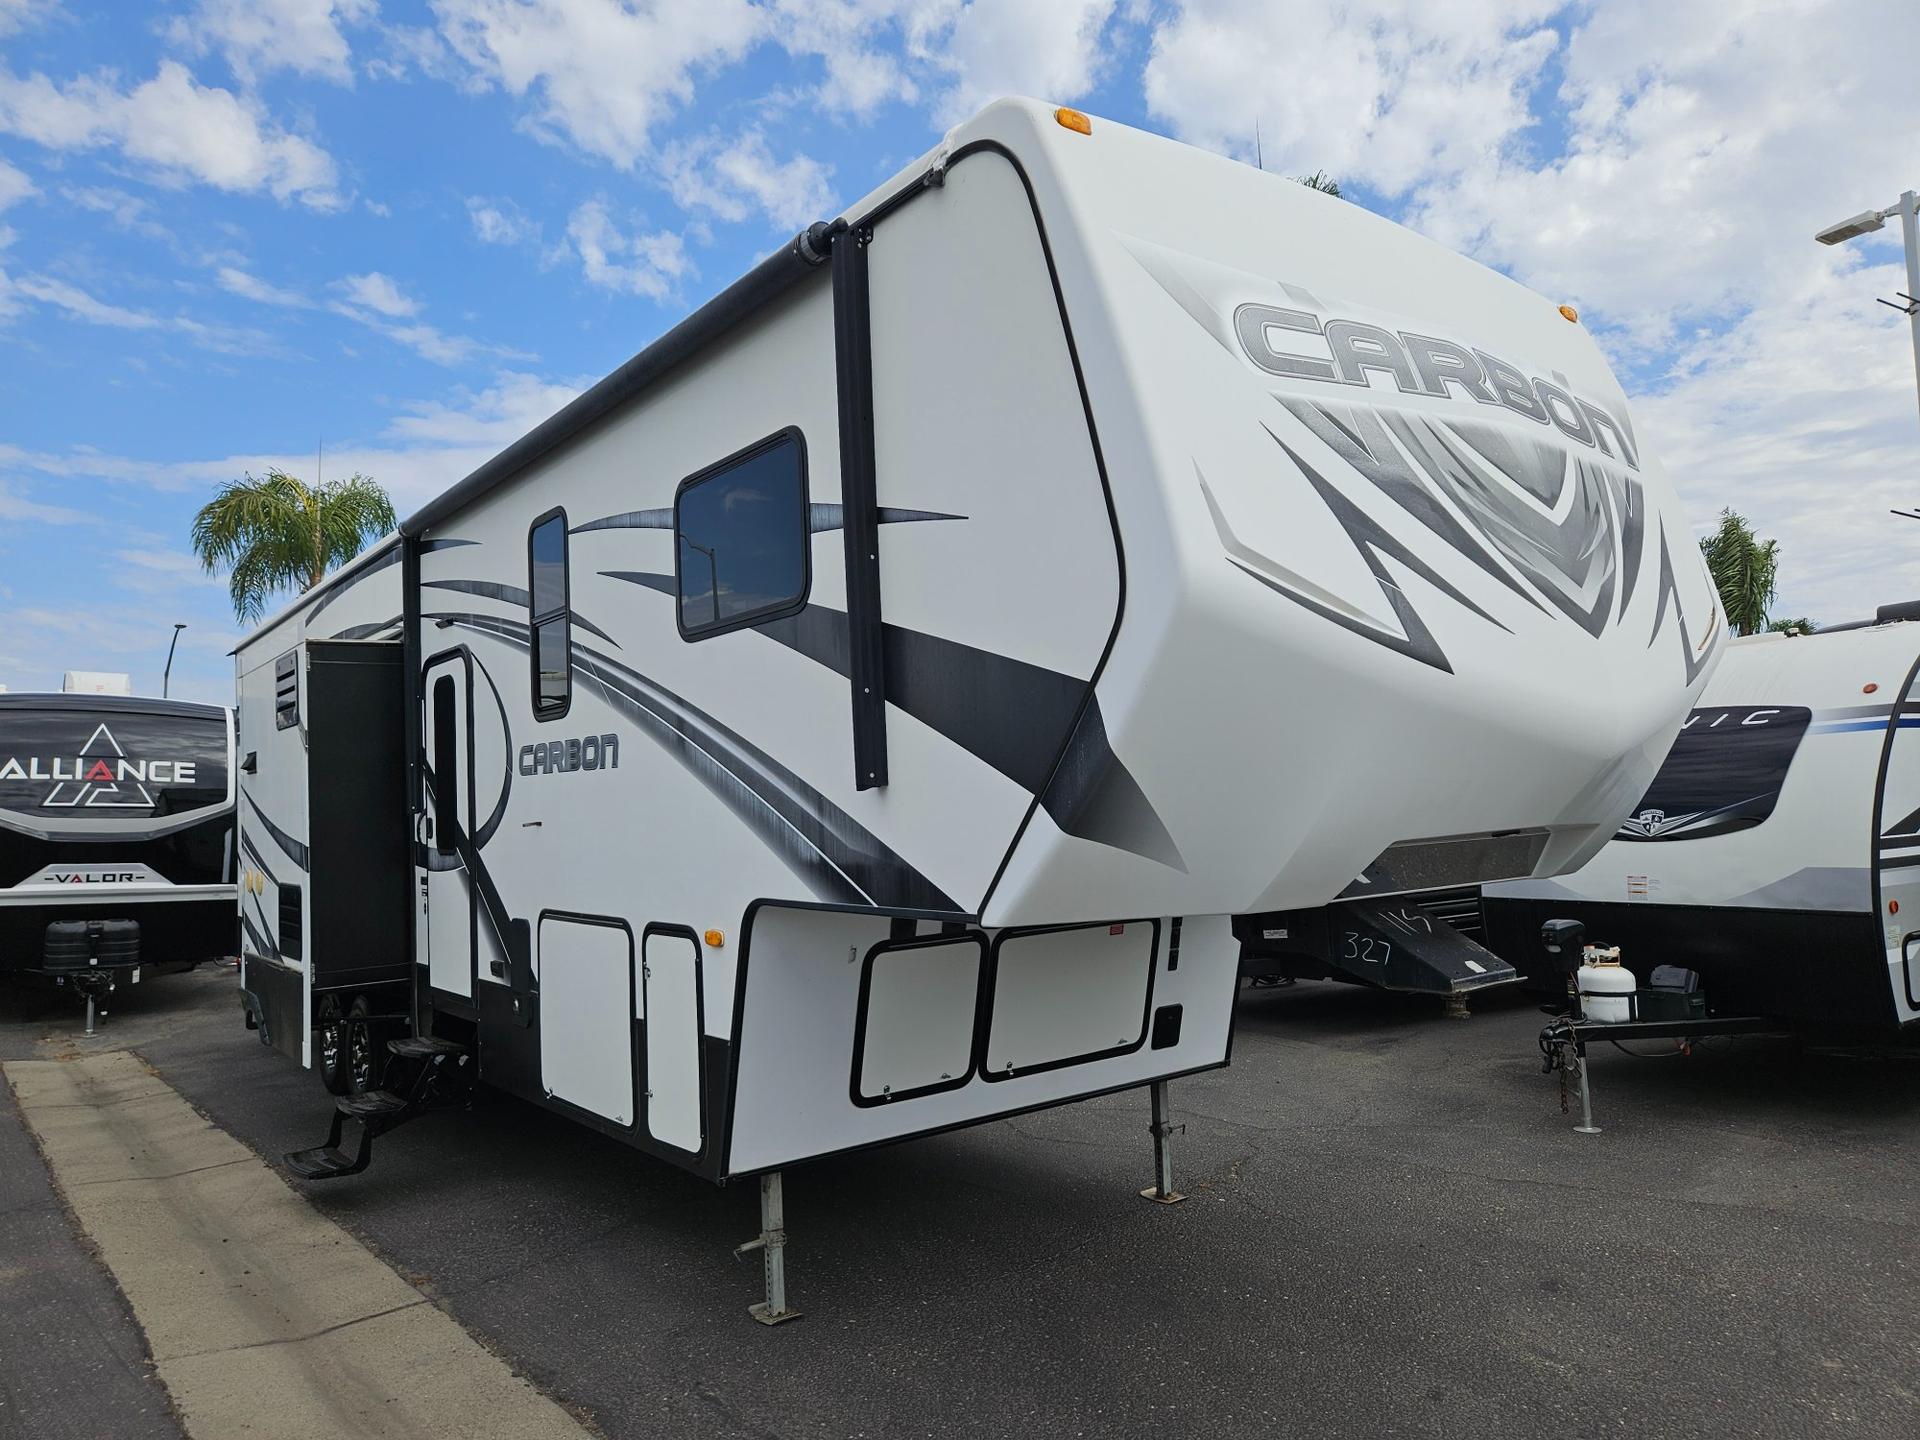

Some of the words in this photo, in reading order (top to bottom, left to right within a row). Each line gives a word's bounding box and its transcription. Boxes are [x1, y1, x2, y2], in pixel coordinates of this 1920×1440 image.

[1233, 302, 1640, 472] CARBON
[0, 756, 196, 784] ALLIANCE
[518, 733, 619, 777] CARBON
[1344, 931, 1391, 966] 327
